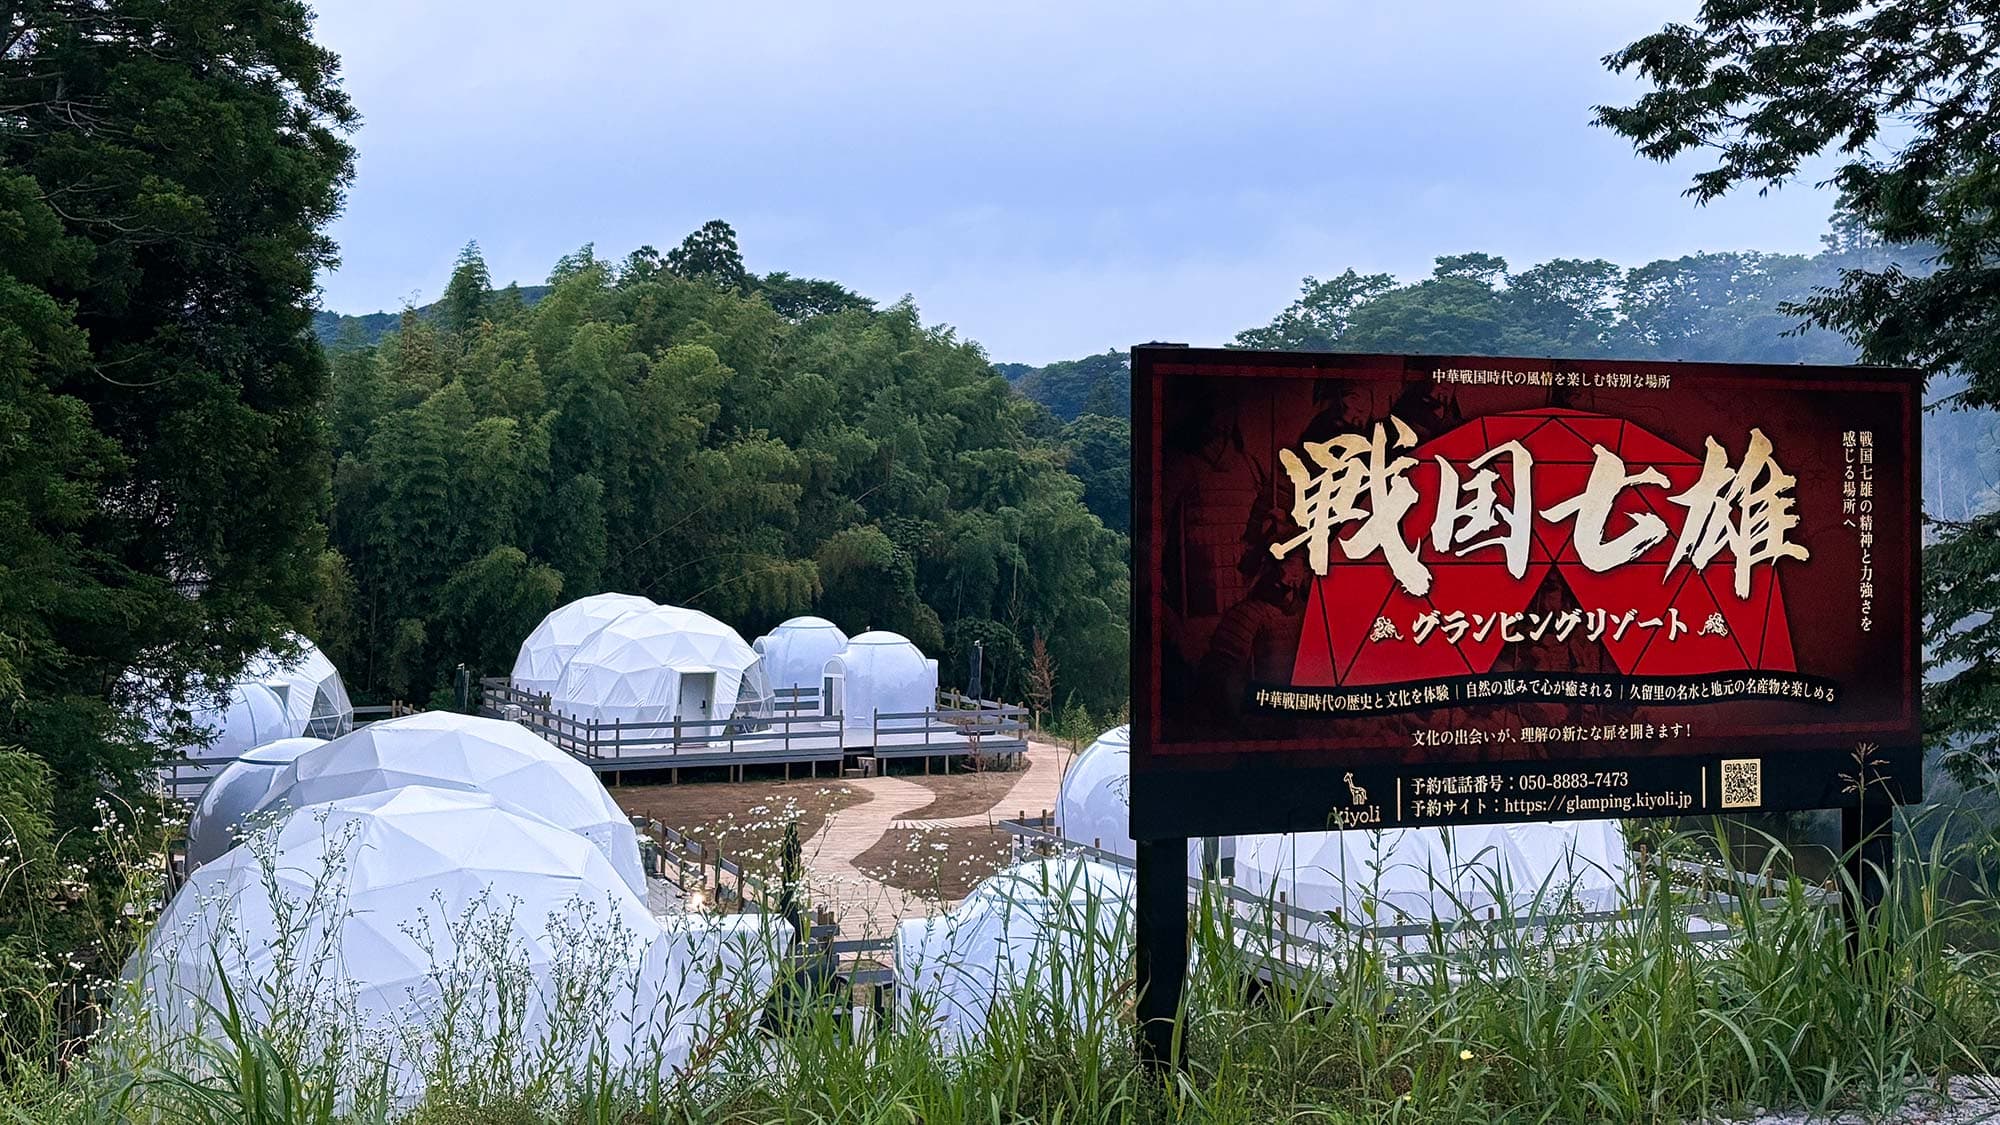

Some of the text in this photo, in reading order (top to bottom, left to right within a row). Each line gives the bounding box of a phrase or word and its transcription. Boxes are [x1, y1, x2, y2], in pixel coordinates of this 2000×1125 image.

[1432, 368, 1671, 389] 中華戦国時代の風情を楽しむ特別な場所
[1842, 430, 1857, 528] 感じる場所へ
[1269, 415, 1809, 599] 戦国七雄
[1859, 430, 1873, 631] 戦国七雄の精神と力強さを
[1411, 607, 1688, 644] グランピングリゾート
[1256, 678, 1835, 711] 中華戦国時代の歴史と文化を体験 自然の恵みで心が癒される 久留里の名水と地元の名産物を楽しめる
[1333, 805, 1381, 827] kiyoli
